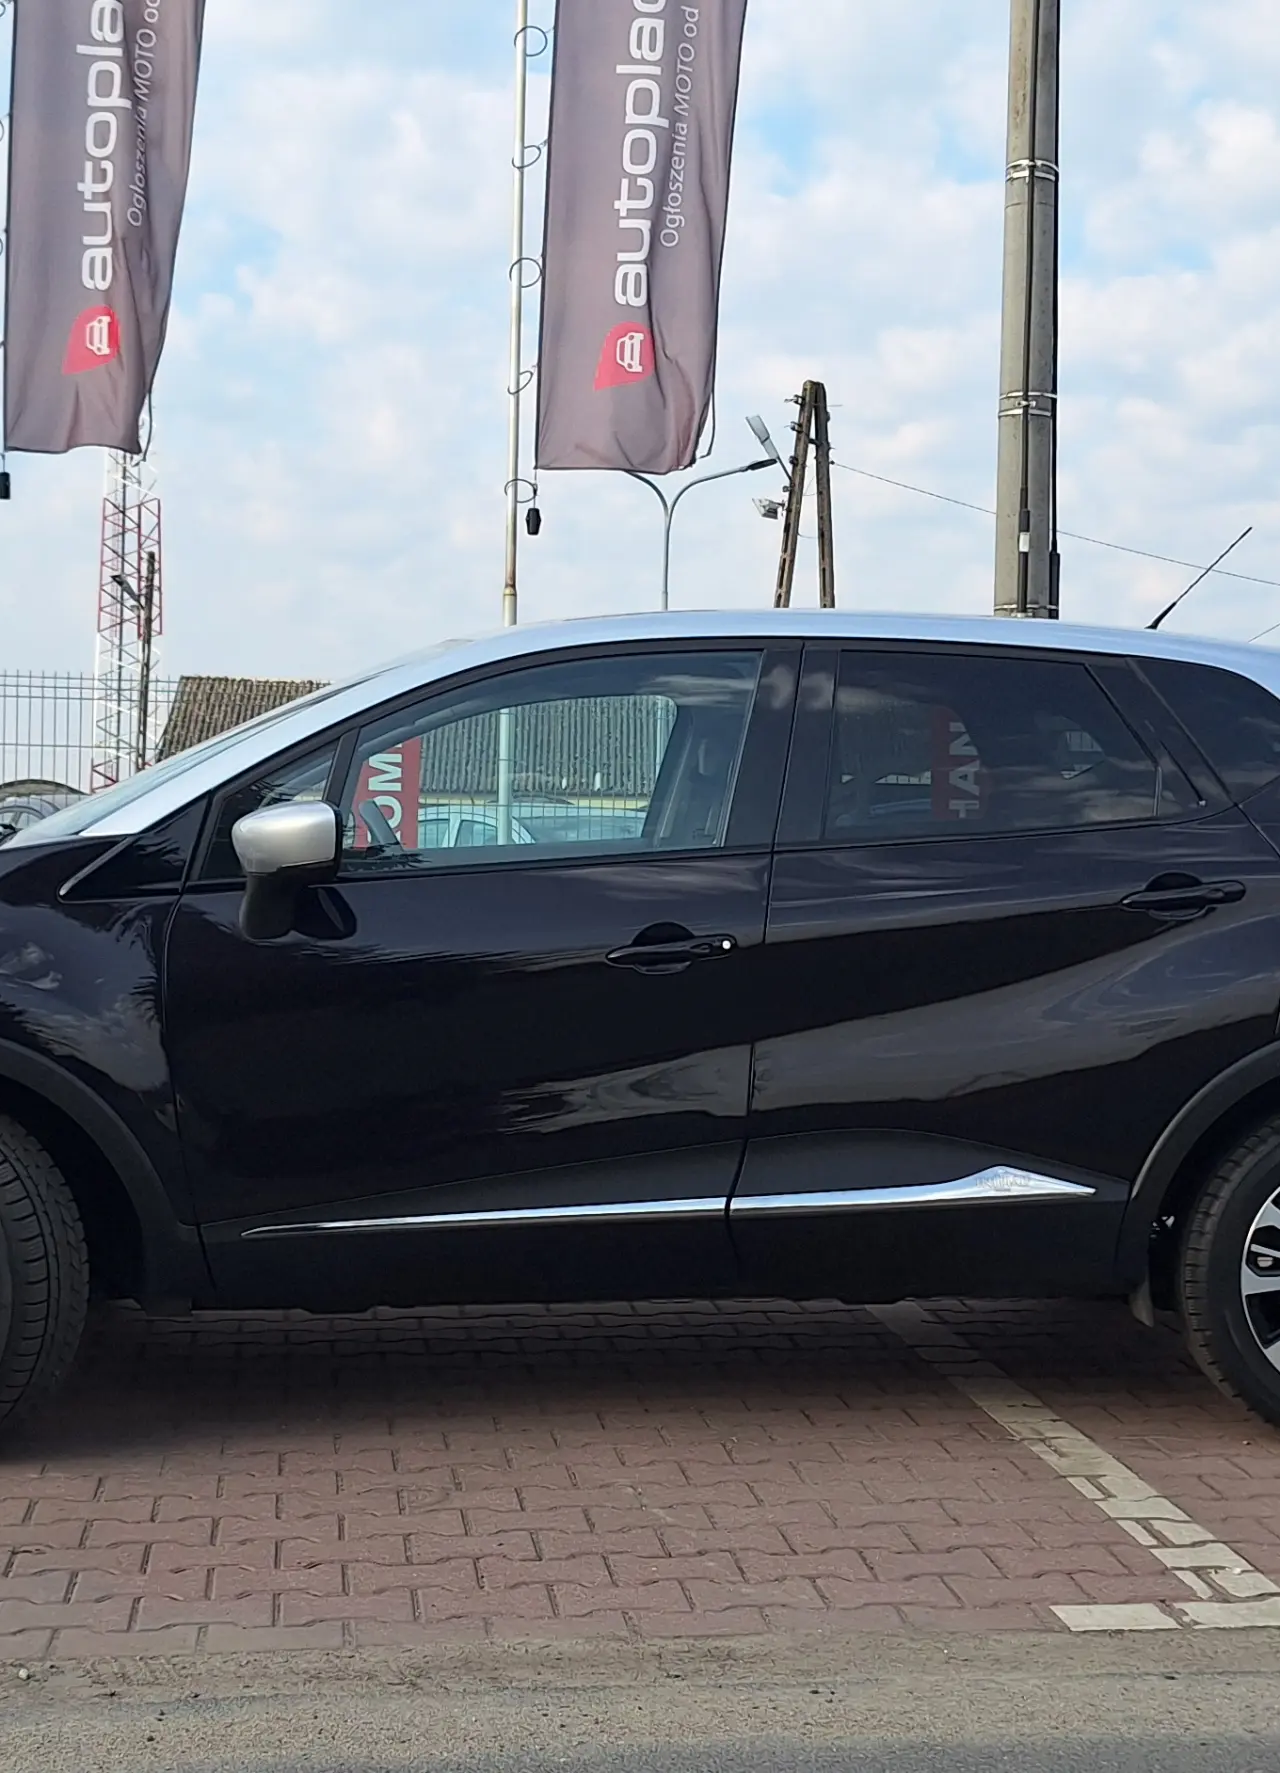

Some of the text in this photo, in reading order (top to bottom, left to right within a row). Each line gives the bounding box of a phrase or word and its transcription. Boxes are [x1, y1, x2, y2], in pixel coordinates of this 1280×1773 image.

[133, 28, 157, 102] MOTO
[659, 6, 700, 248] Ogłoszenia MOTO od
